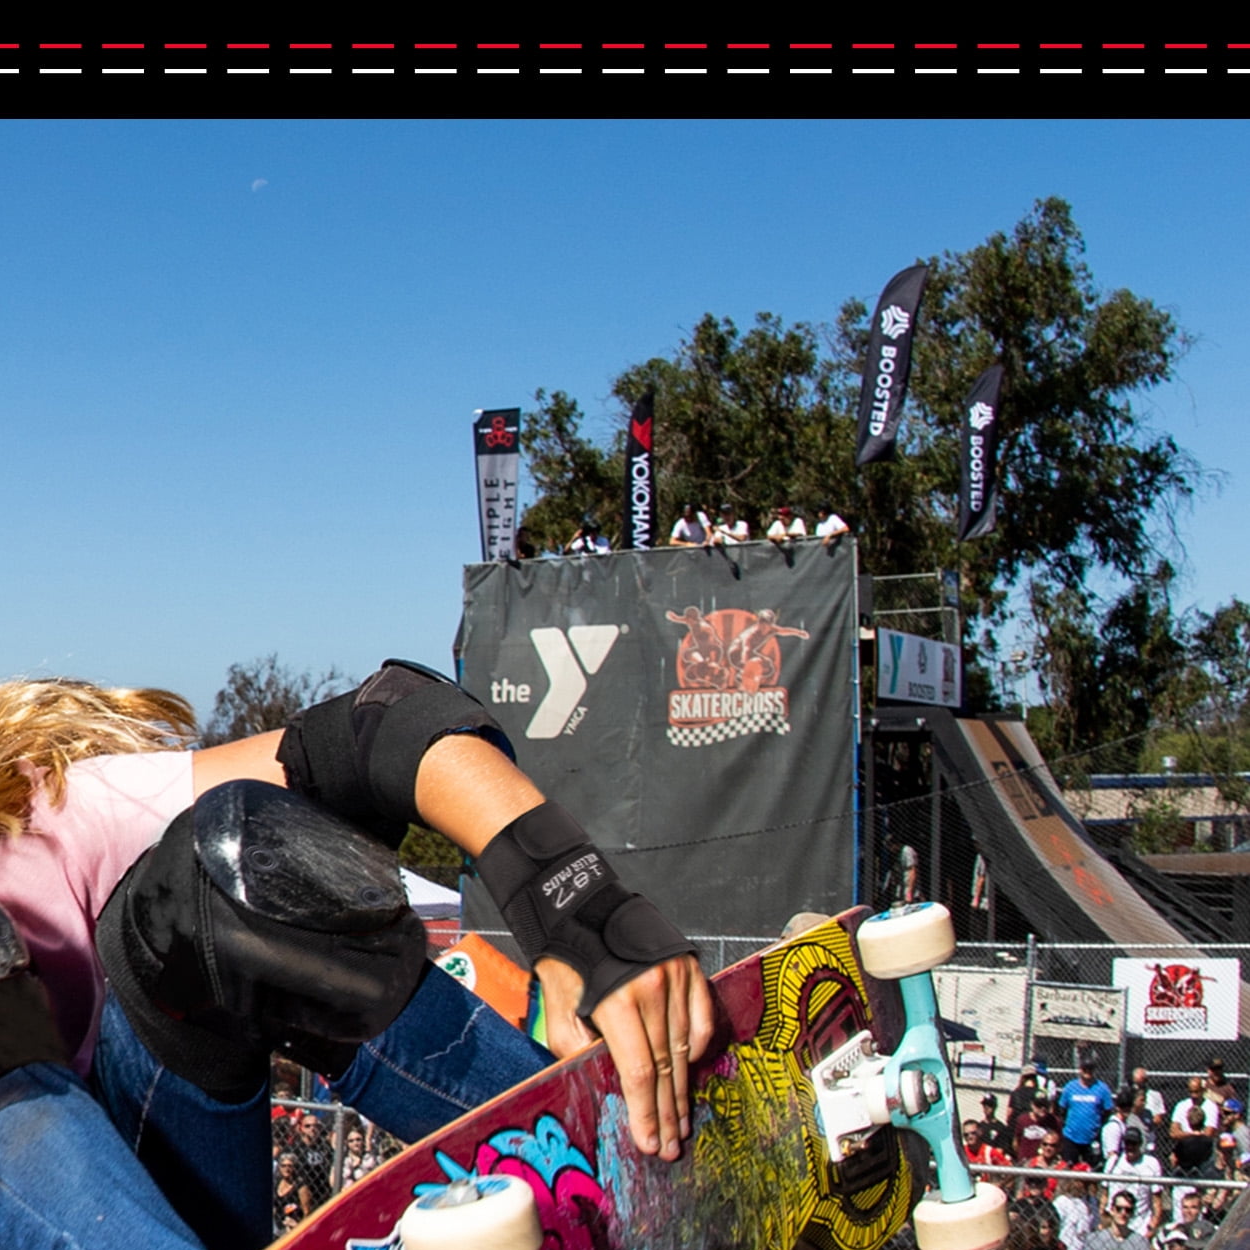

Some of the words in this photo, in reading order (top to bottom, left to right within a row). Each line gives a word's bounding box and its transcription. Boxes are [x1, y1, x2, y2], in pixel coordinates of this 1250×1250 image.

[868, 345, 897, 437] BOOSTED
[969, 435, 984, 512] BOOSTED
[491, 678, 531, 703] the
[670, 691, 786, 720] SKATERCROSS
[563, 705, 588, 736] YMCA
[542, 866, 573, 896] PADS
[554, 864, 603, 909] 187
